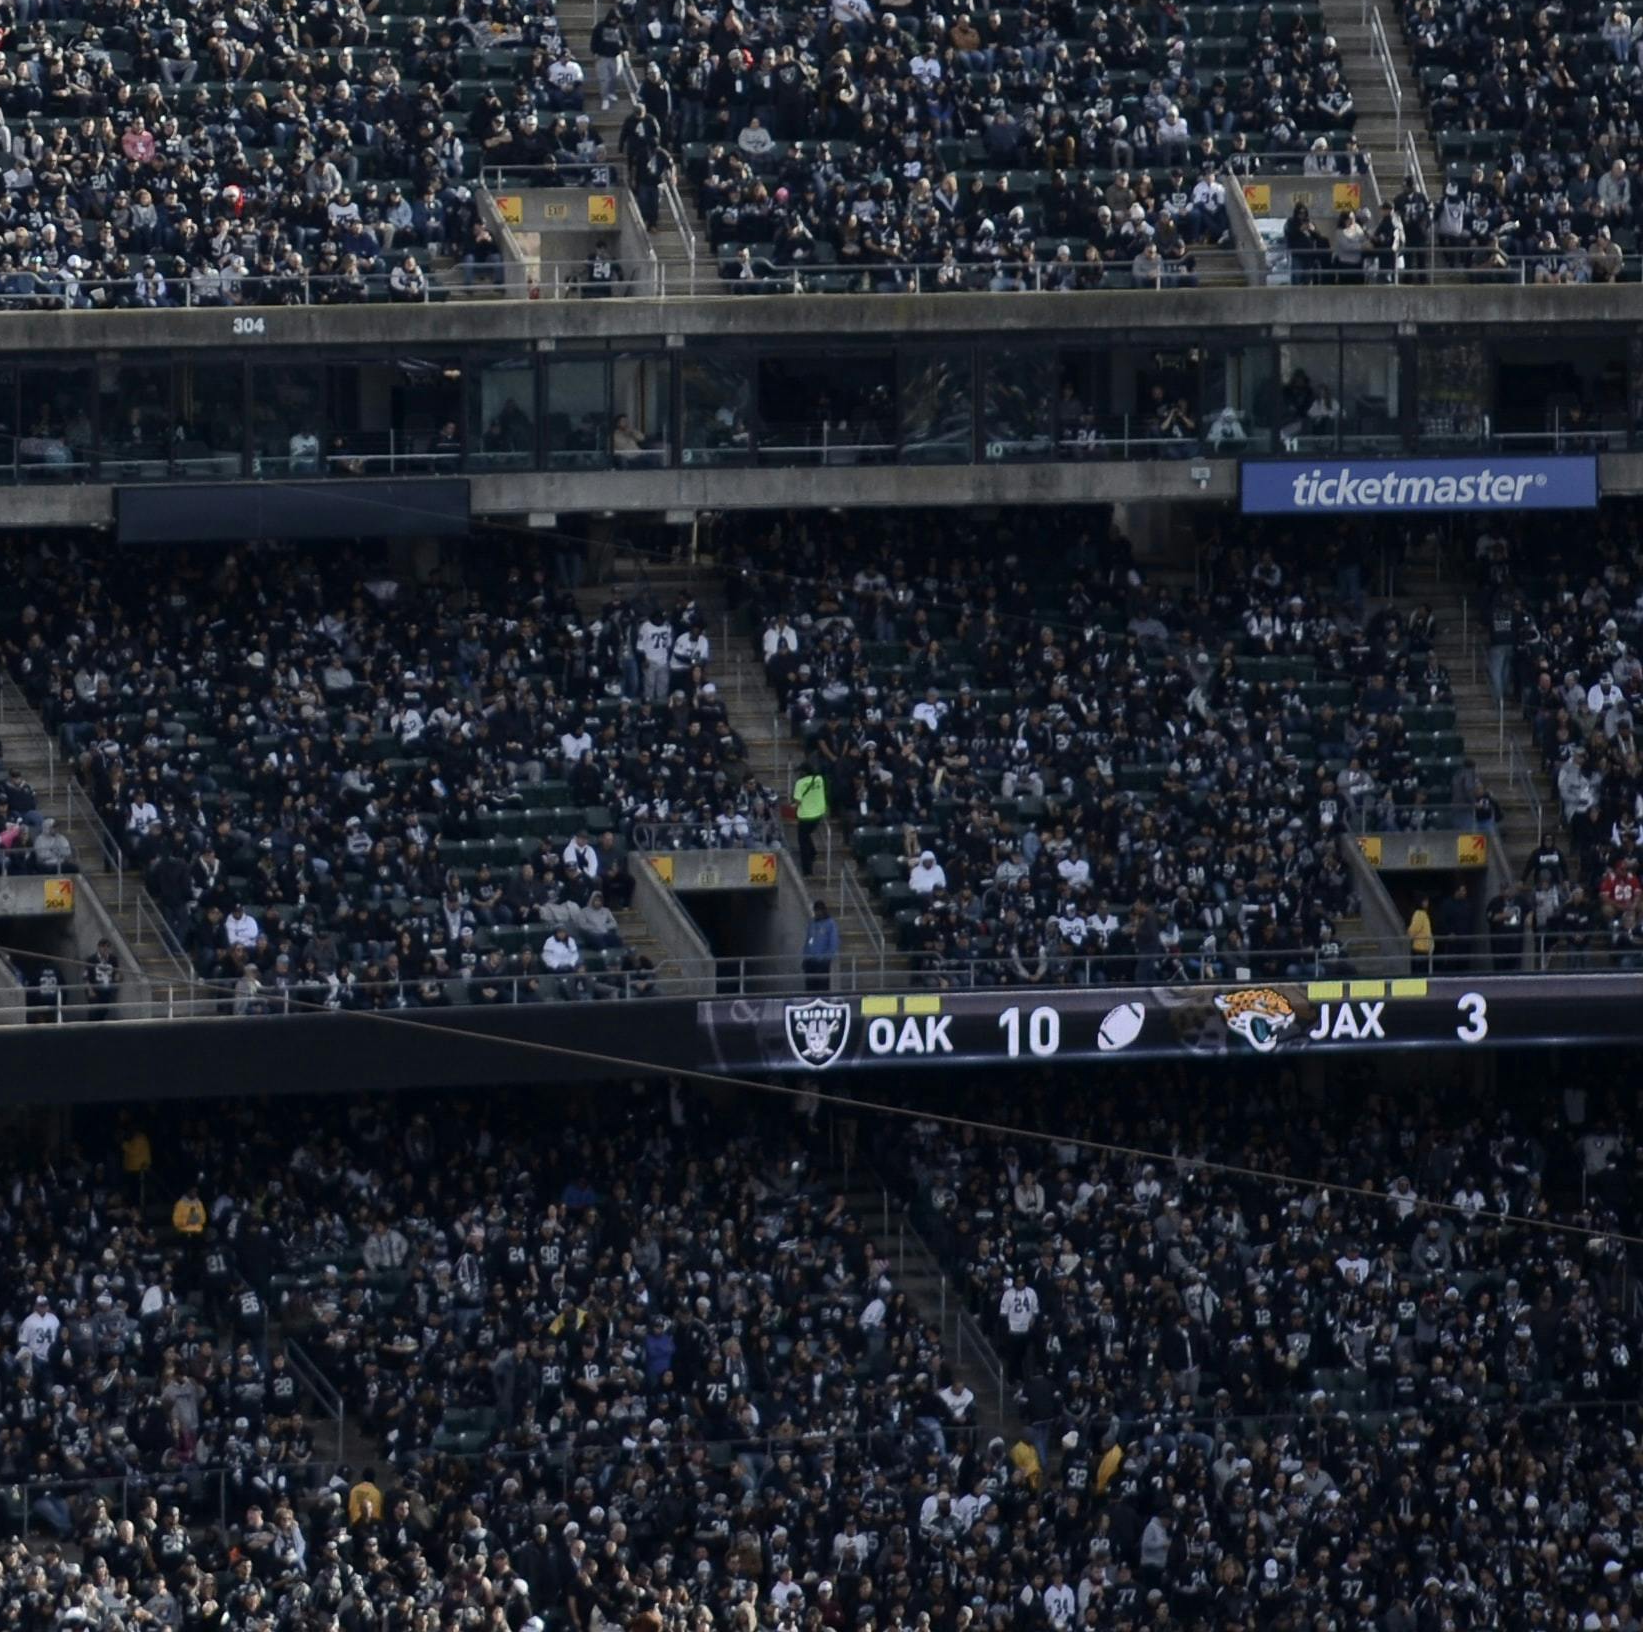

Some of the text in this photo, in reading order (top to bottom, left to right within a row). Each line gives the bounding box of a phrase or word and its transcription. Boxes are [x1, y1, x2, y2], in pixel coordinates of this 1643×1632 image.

[233, 318, 265, 334] 304
[1292, 468, 1534, 506] ticketmaster
[868, 1015, 953, 1054] OAK
[998, 1005, 1060, 1059] 10
[1309, 1001, 1385, 1040] JAX
[1457, 992, 1488, 1043] 3
[1013, 1296, 1031, 1314] 24
[35, 1325, 53, 1344] 34
[706, 1383, 728, 1402] 75
[1341, 1578, 1363, 1599] 37
